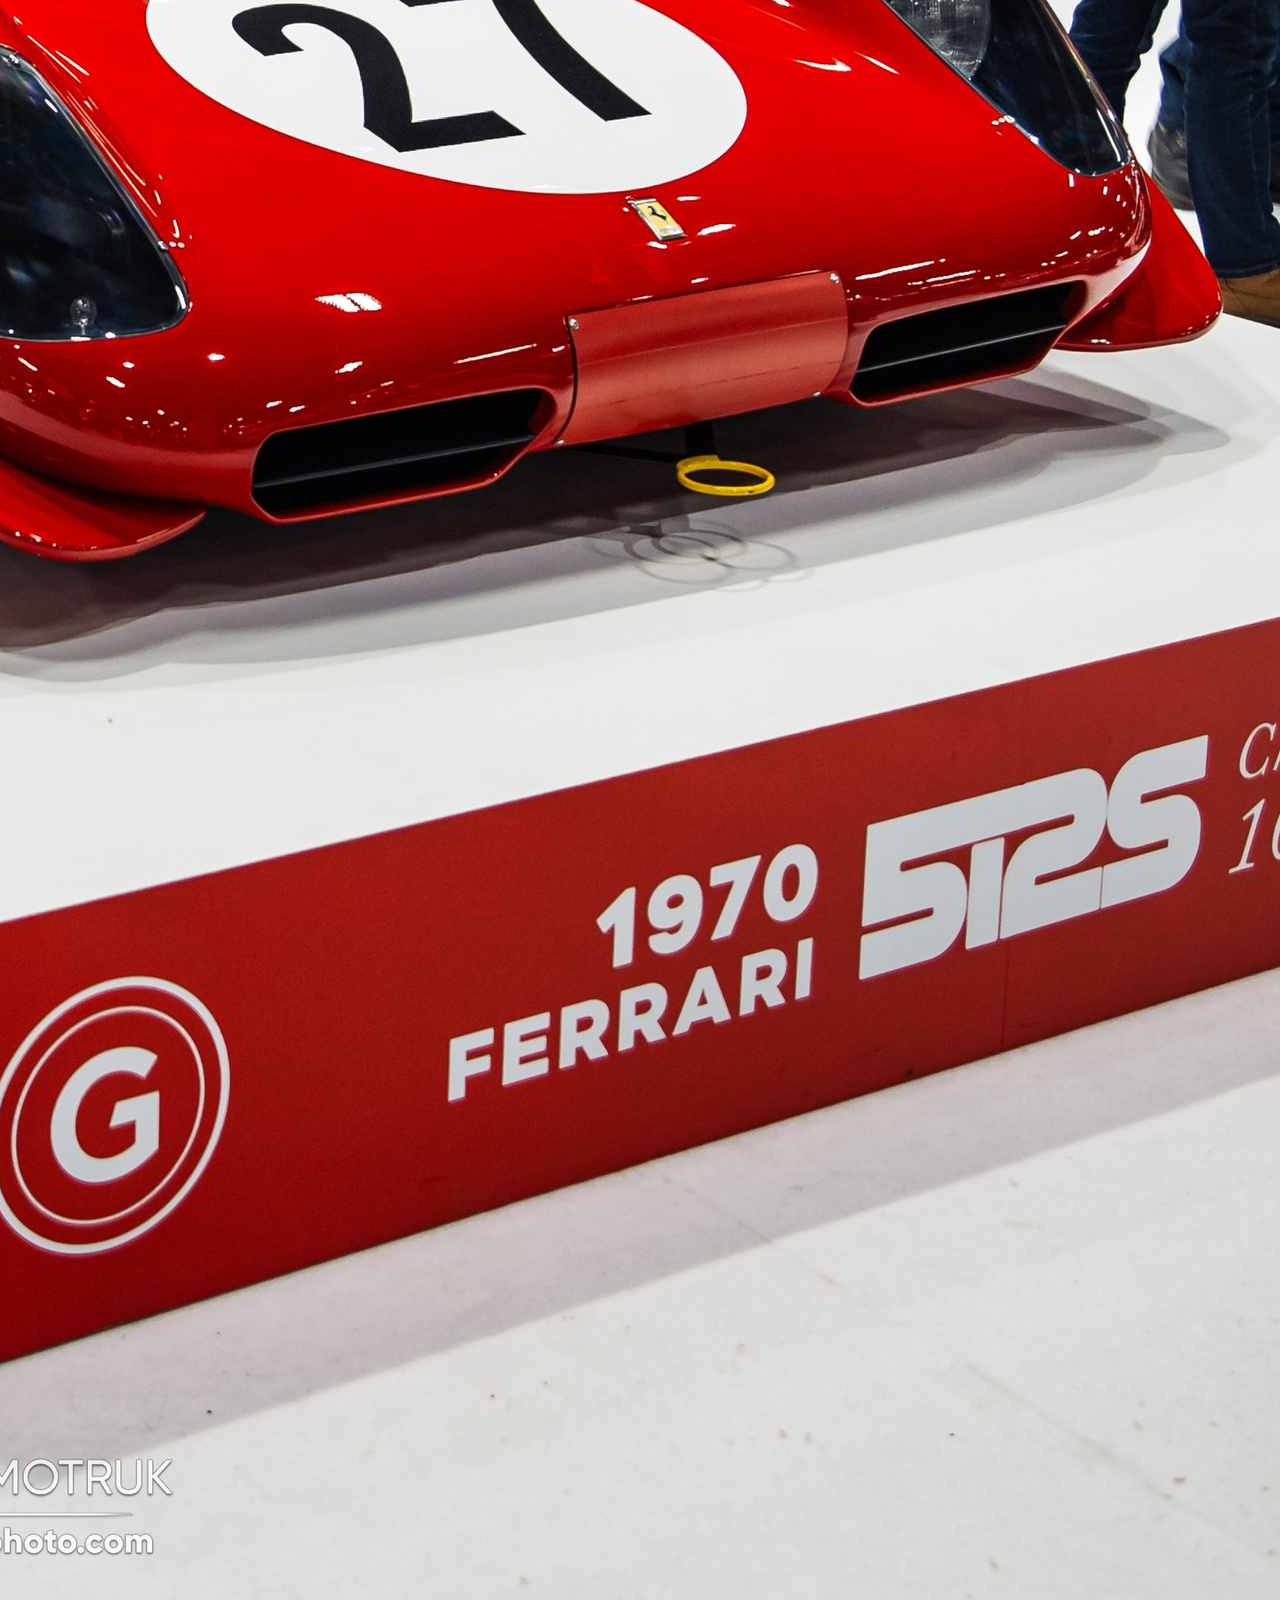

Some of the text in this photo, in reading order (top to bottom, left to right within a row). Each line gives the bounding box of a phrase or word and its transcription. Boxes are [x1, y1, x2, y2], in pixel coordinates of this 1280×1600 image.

[596, 843, 819, 969] 1970
[859, 734, 1209, 981] 512S
[447, 938, 814, 1103] FERRARI
[50, 1045, 160, 1185] G
